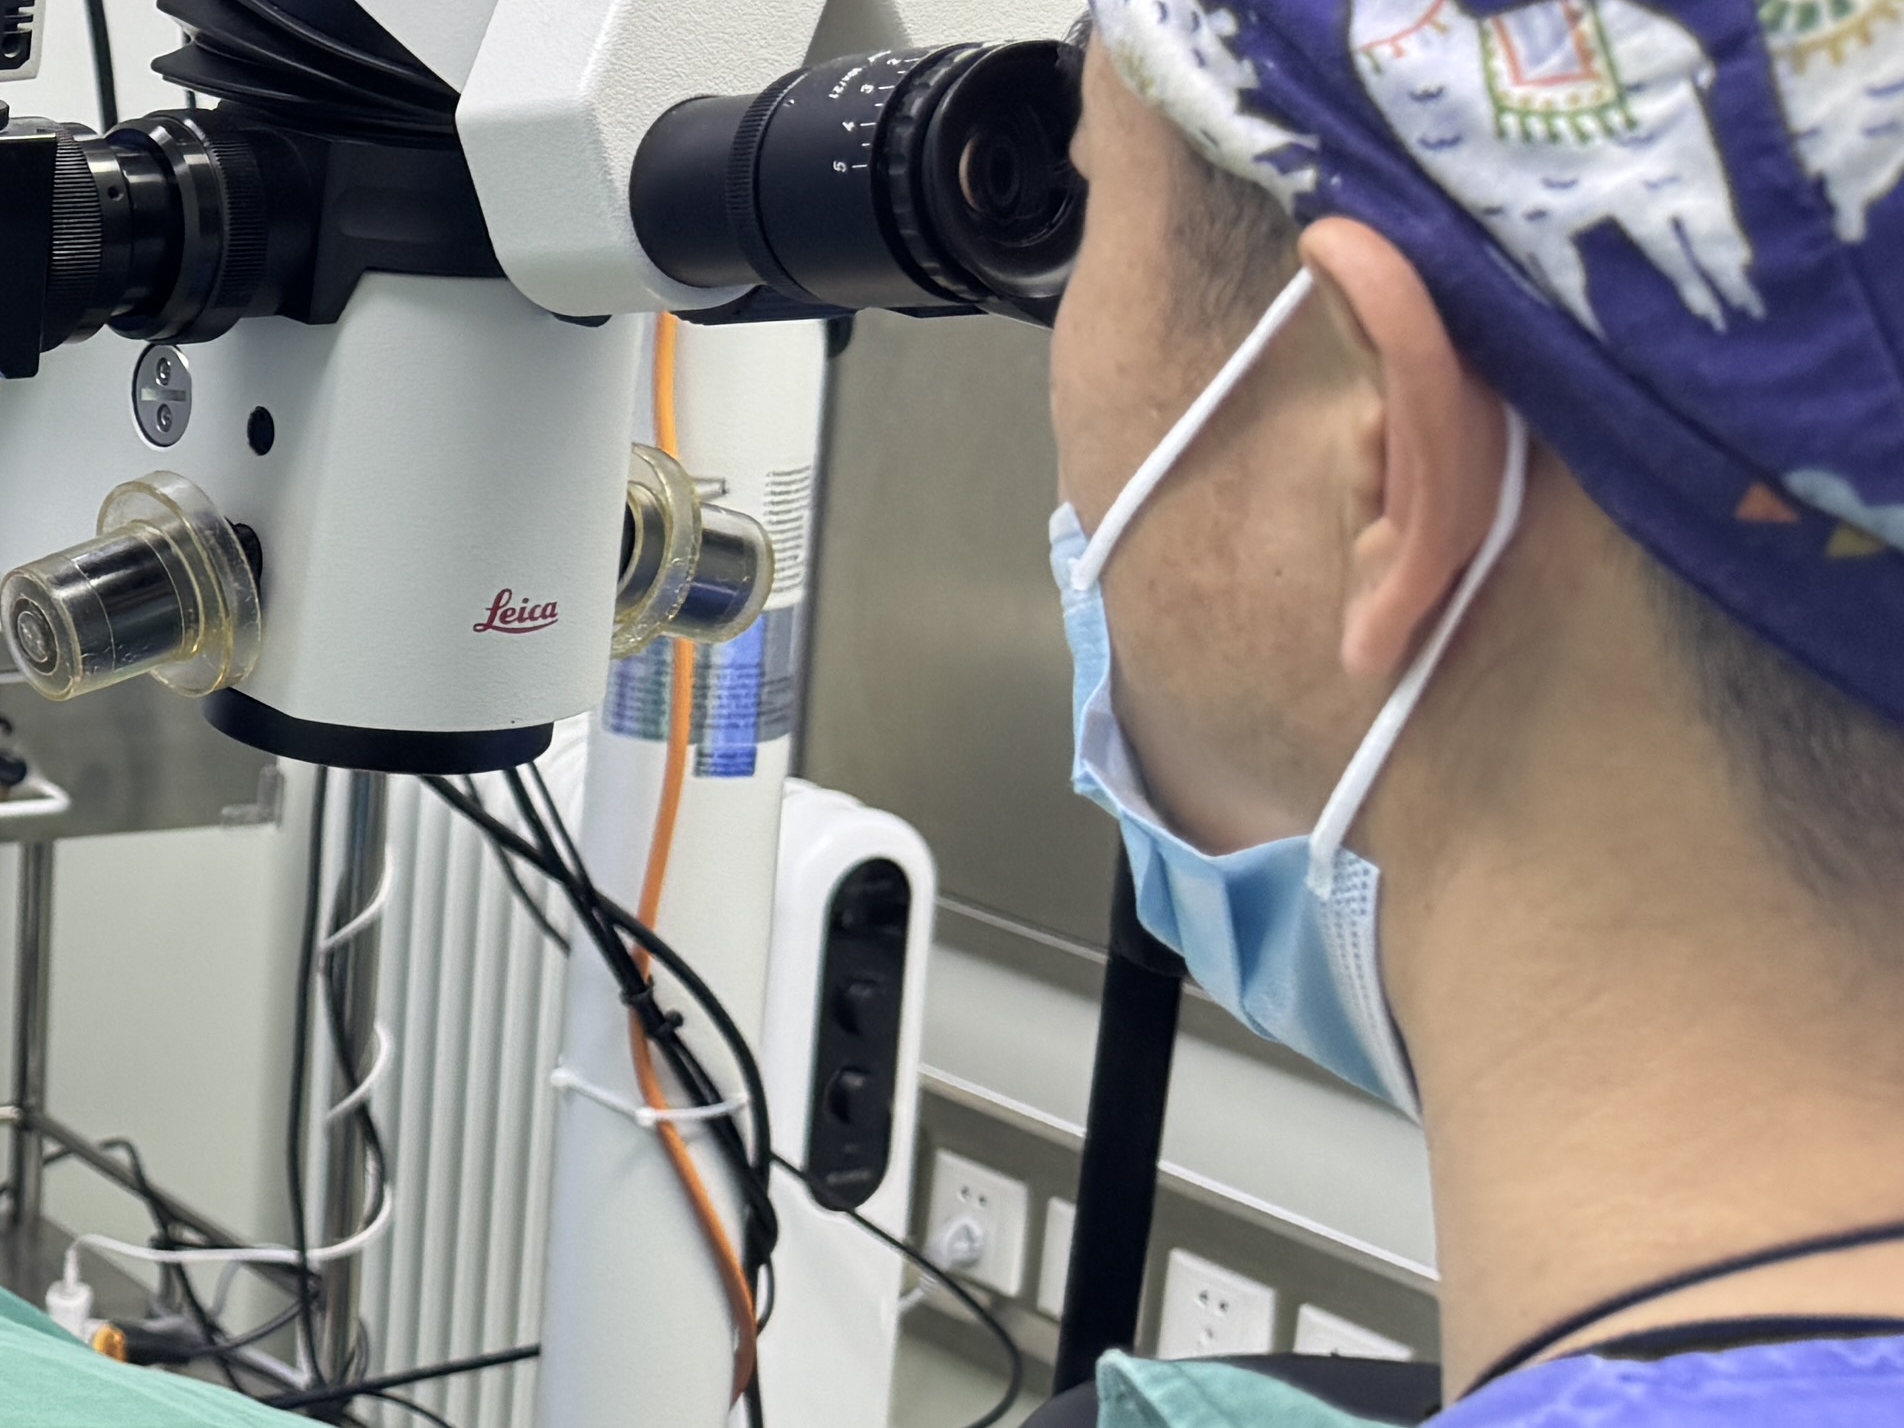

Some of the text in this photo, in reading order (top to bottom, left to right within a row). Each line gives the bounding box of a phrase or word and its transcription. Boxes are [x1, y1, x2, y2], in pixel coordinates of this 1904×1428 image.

[833, 160, 847, 172] 5
[842, 121, 855, 132] 4
[473, 588, 560, 634] Leica
